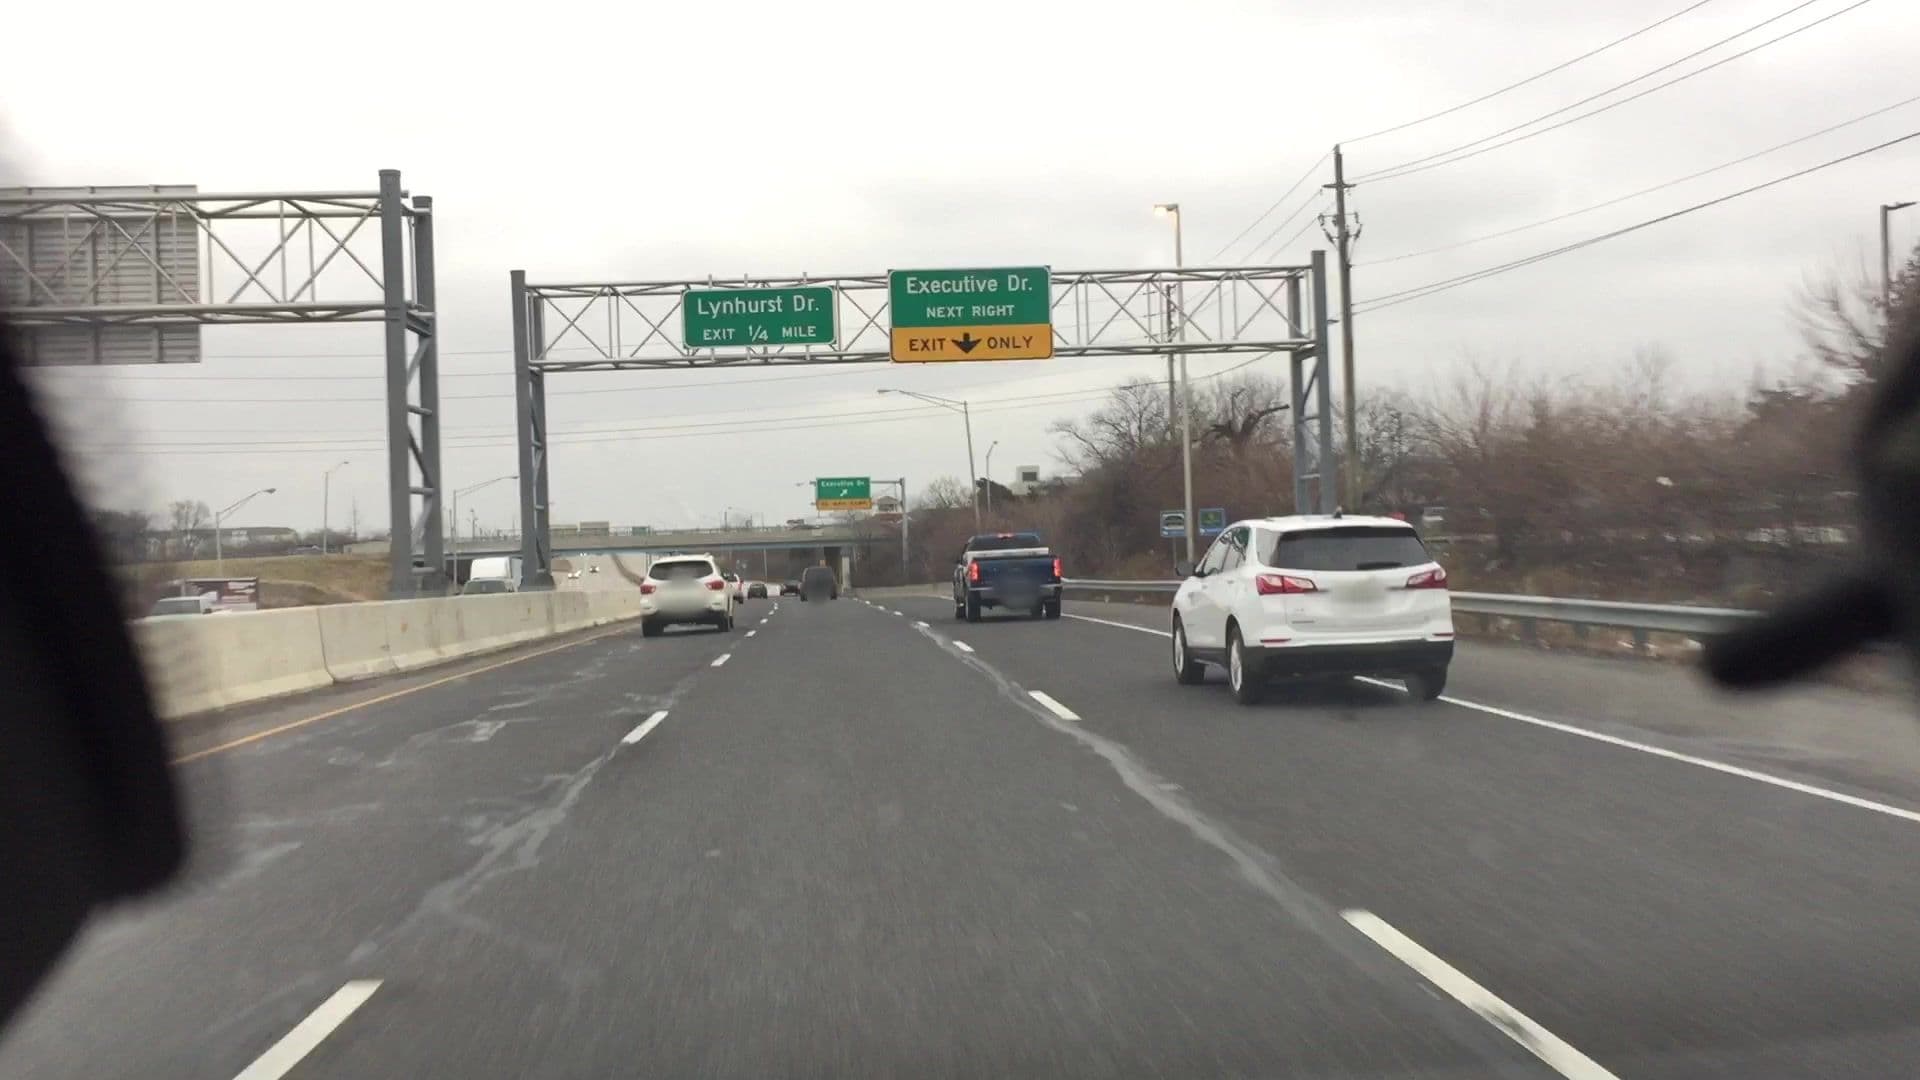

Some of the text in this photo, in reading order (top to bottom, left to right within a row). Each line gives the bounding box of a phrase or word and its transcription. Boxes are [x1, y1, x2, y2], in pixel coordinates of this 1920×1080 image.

[906, 274, 1033, 294] Executive Dr.
[697, 294, 820, 319] Lynhurst Dr.
[926, 304, 1015, 318] NEXT RIGHT
[703, 328, 735, 341] EXIT
[782, 325, 817, 338] MILE
[908, 336, 1033, 352] EXIT ONLY
